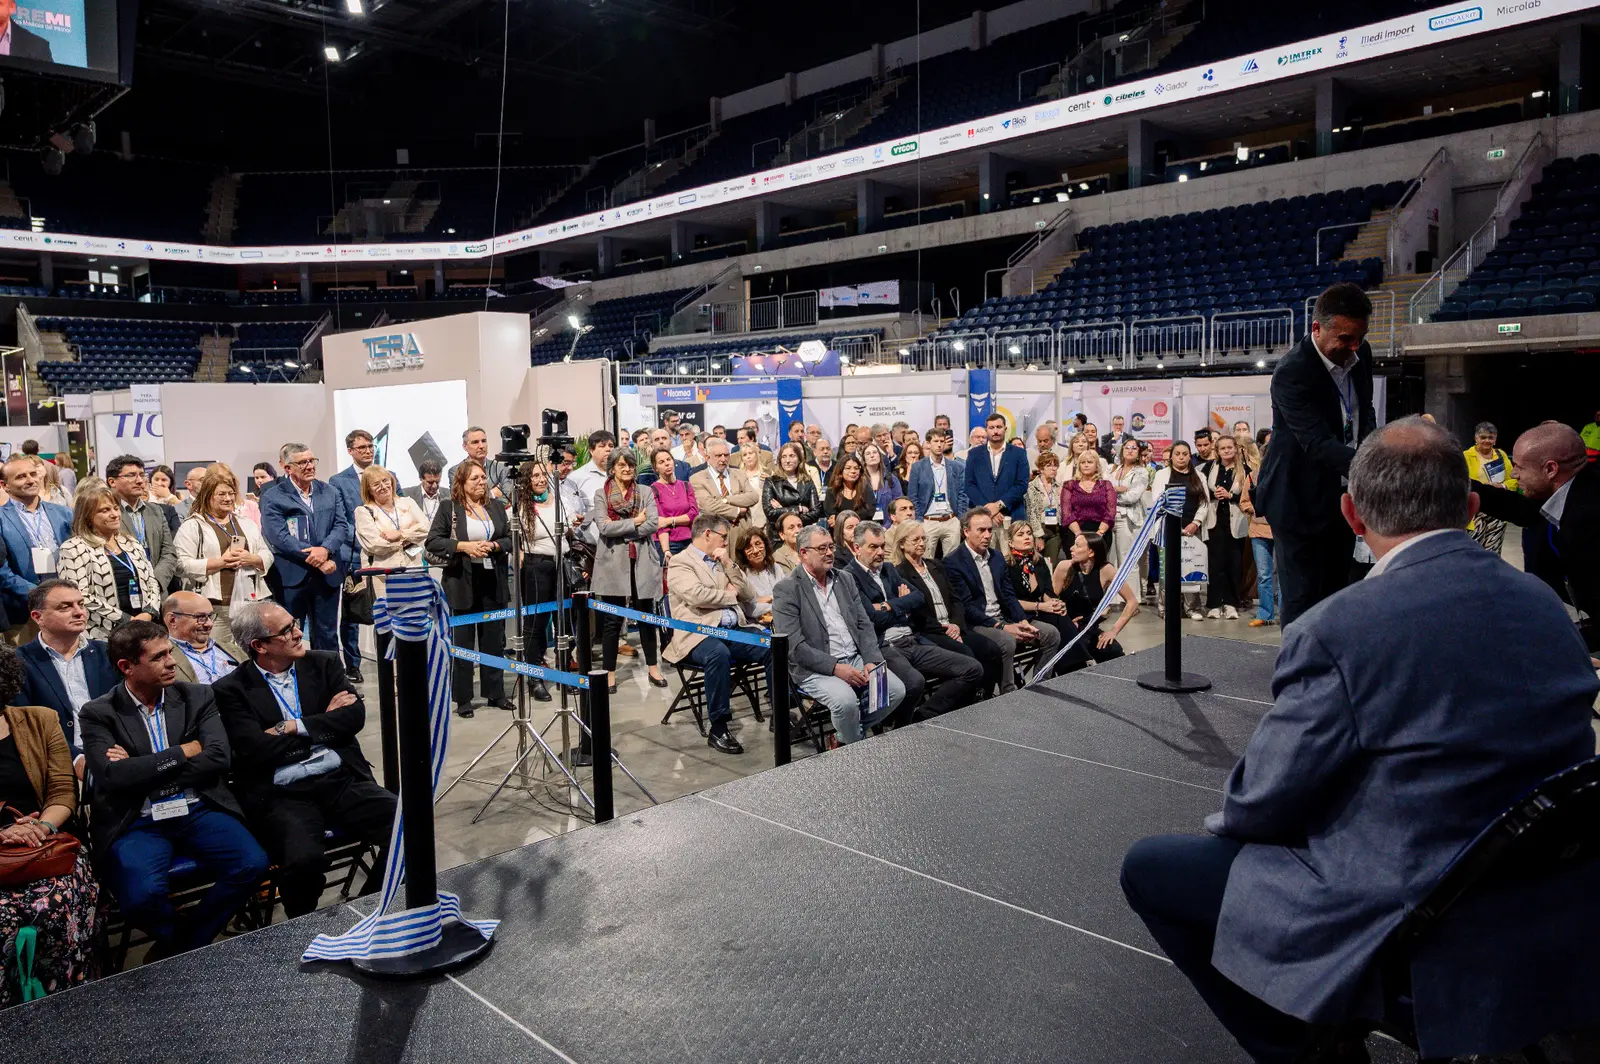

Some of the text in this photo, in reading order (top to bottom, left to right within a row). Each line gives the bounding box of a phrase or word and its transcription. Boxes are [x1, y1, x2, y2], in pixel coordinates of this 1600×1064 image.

[1496, 0, 1542, 16] Microlab
[1385, 25, 1415, 39] Import
[1289, 47, 1323, 60] IMTREX
[1165, 81, 1188, 92] Gador
[1115, 90, 1146, 102] cibeles
[1067, 100, 1091, 113] cenit
[975, 125, 994, 135] Adium
[893, 143, 917, 156] VYGON
[362, 333, 422, 359] TERA
[667, 389, 691, 398] Neomed
